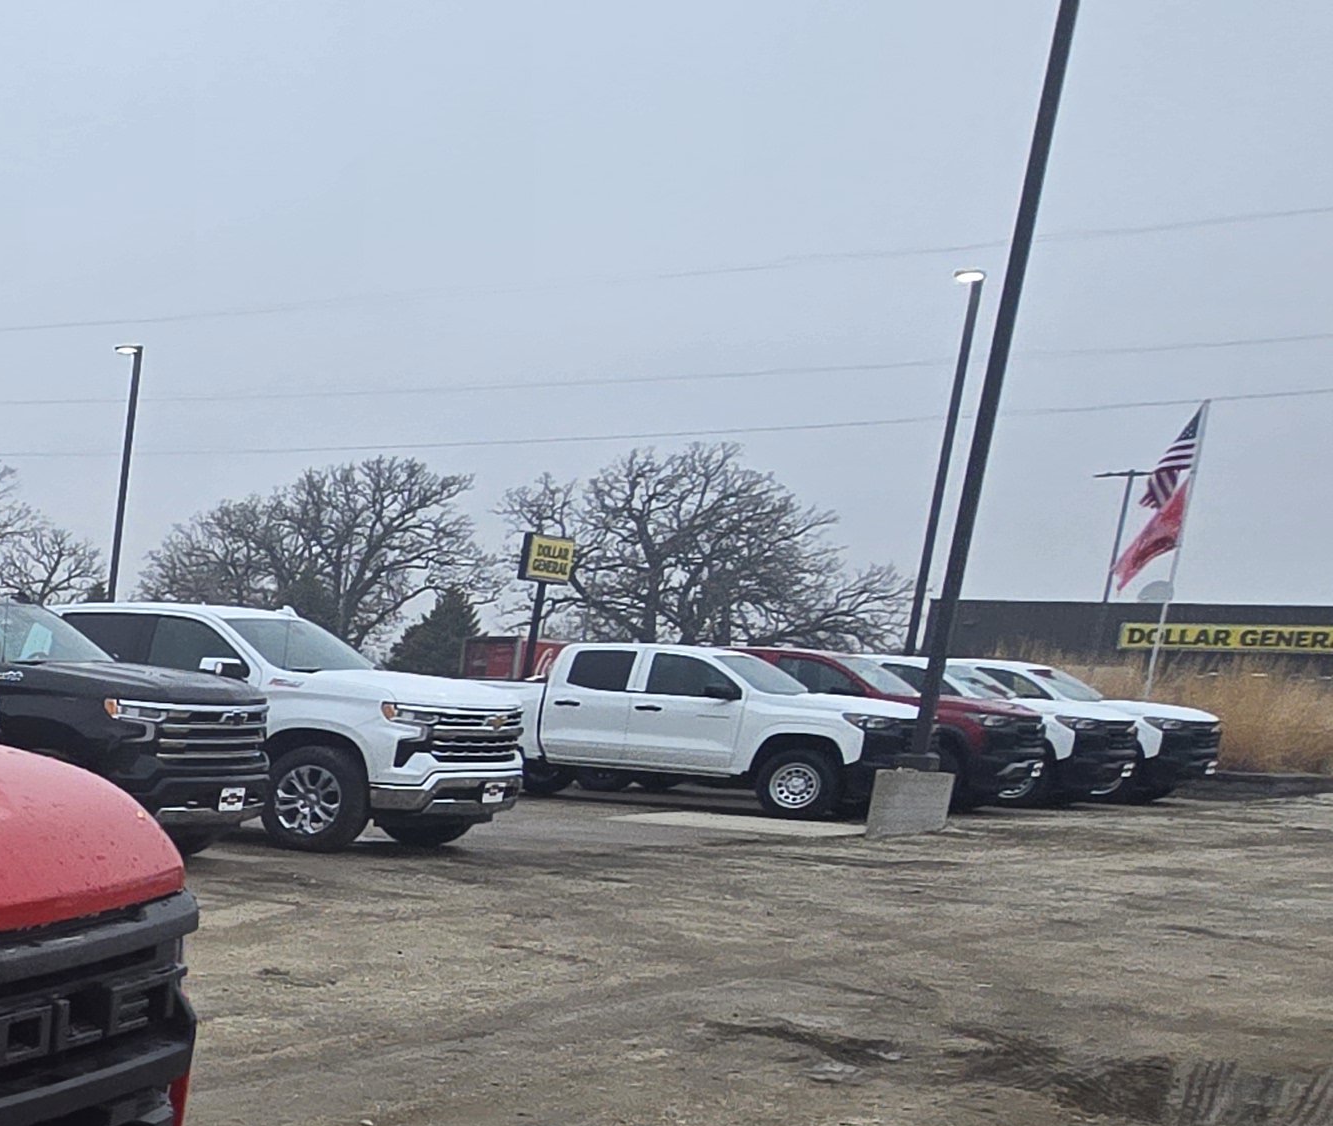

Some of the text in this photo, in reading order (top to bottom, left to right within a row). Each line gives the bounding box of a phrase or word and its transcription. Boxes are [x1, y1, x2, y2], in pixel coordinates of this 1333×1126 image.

[537, 544, 569, 560] DOLLAR
[1127, 628, 1333, 648] DOLLAR GENER
